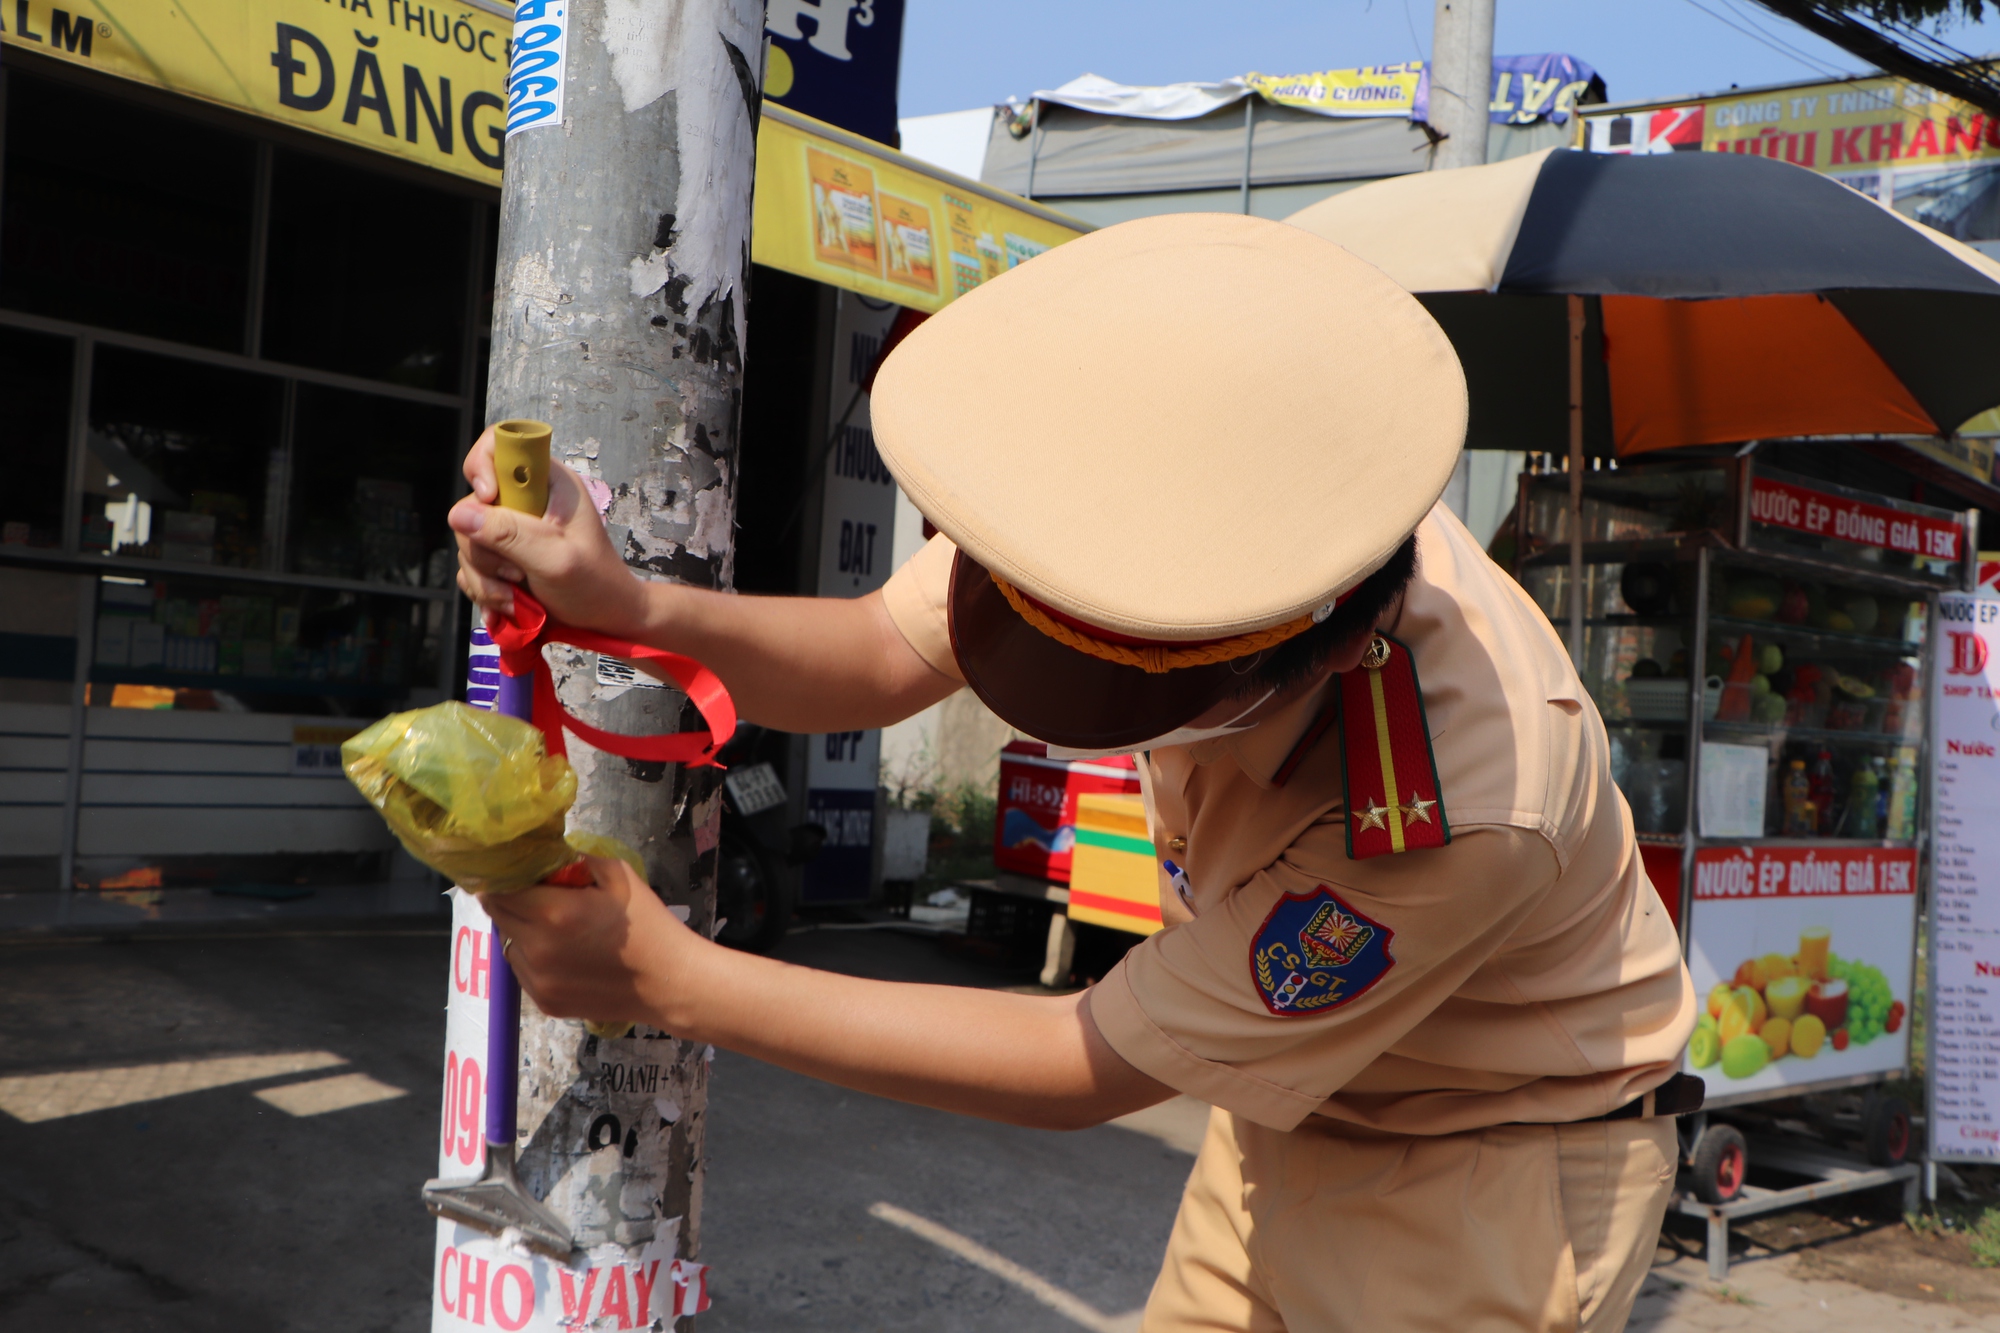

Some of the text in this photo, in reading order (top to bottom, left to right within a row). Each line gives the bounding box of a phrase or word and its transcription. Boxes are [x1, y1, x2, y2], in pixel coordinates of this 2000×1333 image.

[271, 22, 507, 170] ĐĂNG
[1714, 100, 1781, 128] CÔNG
[1790, 95, 1819, 119] TY
[1826, 86, 1896, 115] TNHH
[1805, 496, 1830, 531] ÉP
[1924, 528, 1956, 559] 15K
[1758, 854, 1786, 894] ÉP
[1845, 855, 1876, 893] GIÁ
[1880, 860, 1912, 891] 15K
[440, 1246, 535, 1332] CHO
